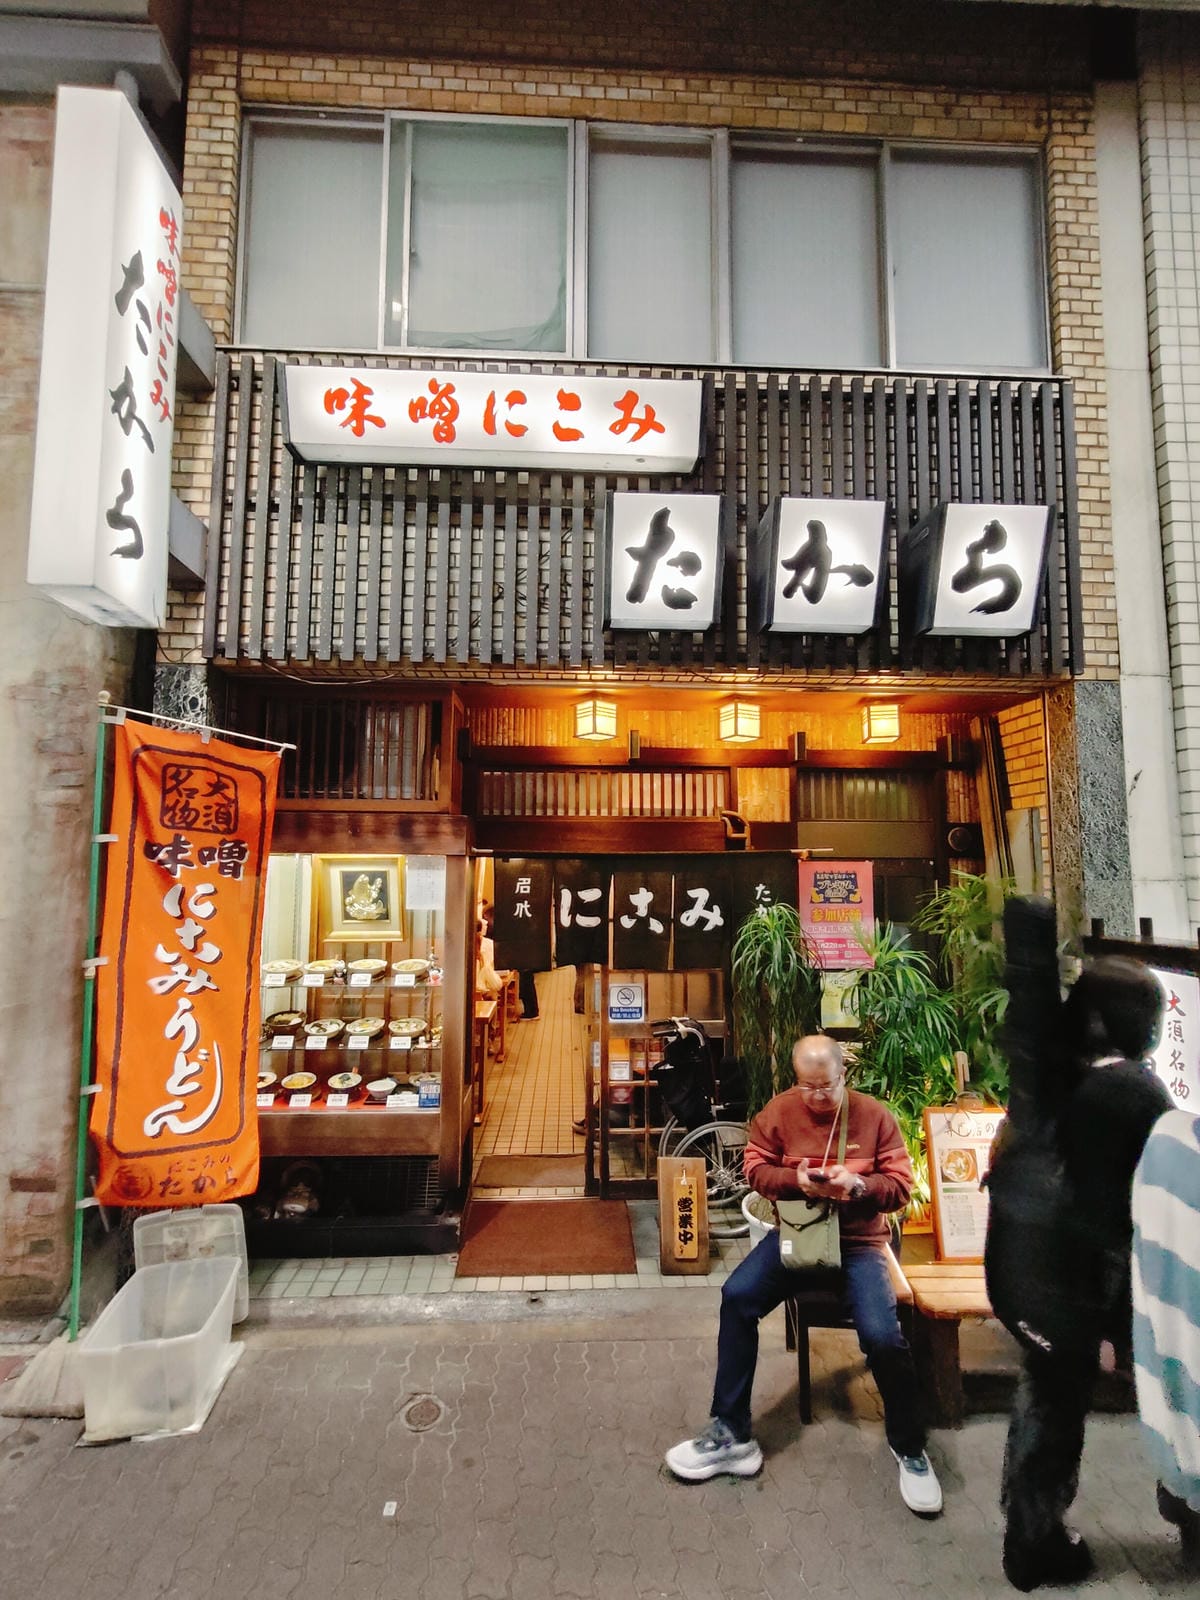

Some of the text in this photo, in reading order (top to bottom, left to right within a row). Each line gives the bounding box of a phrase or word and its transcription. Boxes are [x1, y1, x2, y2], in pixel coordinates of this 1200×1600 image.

[149, 205, 181, 424] 味噌にこみ
[105, 249, 155, 560] たから
[323, 376, 666, 444] 味噌にこみ
[624, 505, 1023, 616] たから
[143, 833, 250, 881] 味噌
[560, 887, 725, 935] にこみ
[143, 882, 224, 1140] にこみうどん
[1165, 990, 1190, 1100] 大須名物
[159, 1166, 238, 1198] たから
[677, 1196, 694, 1246] 営業中
